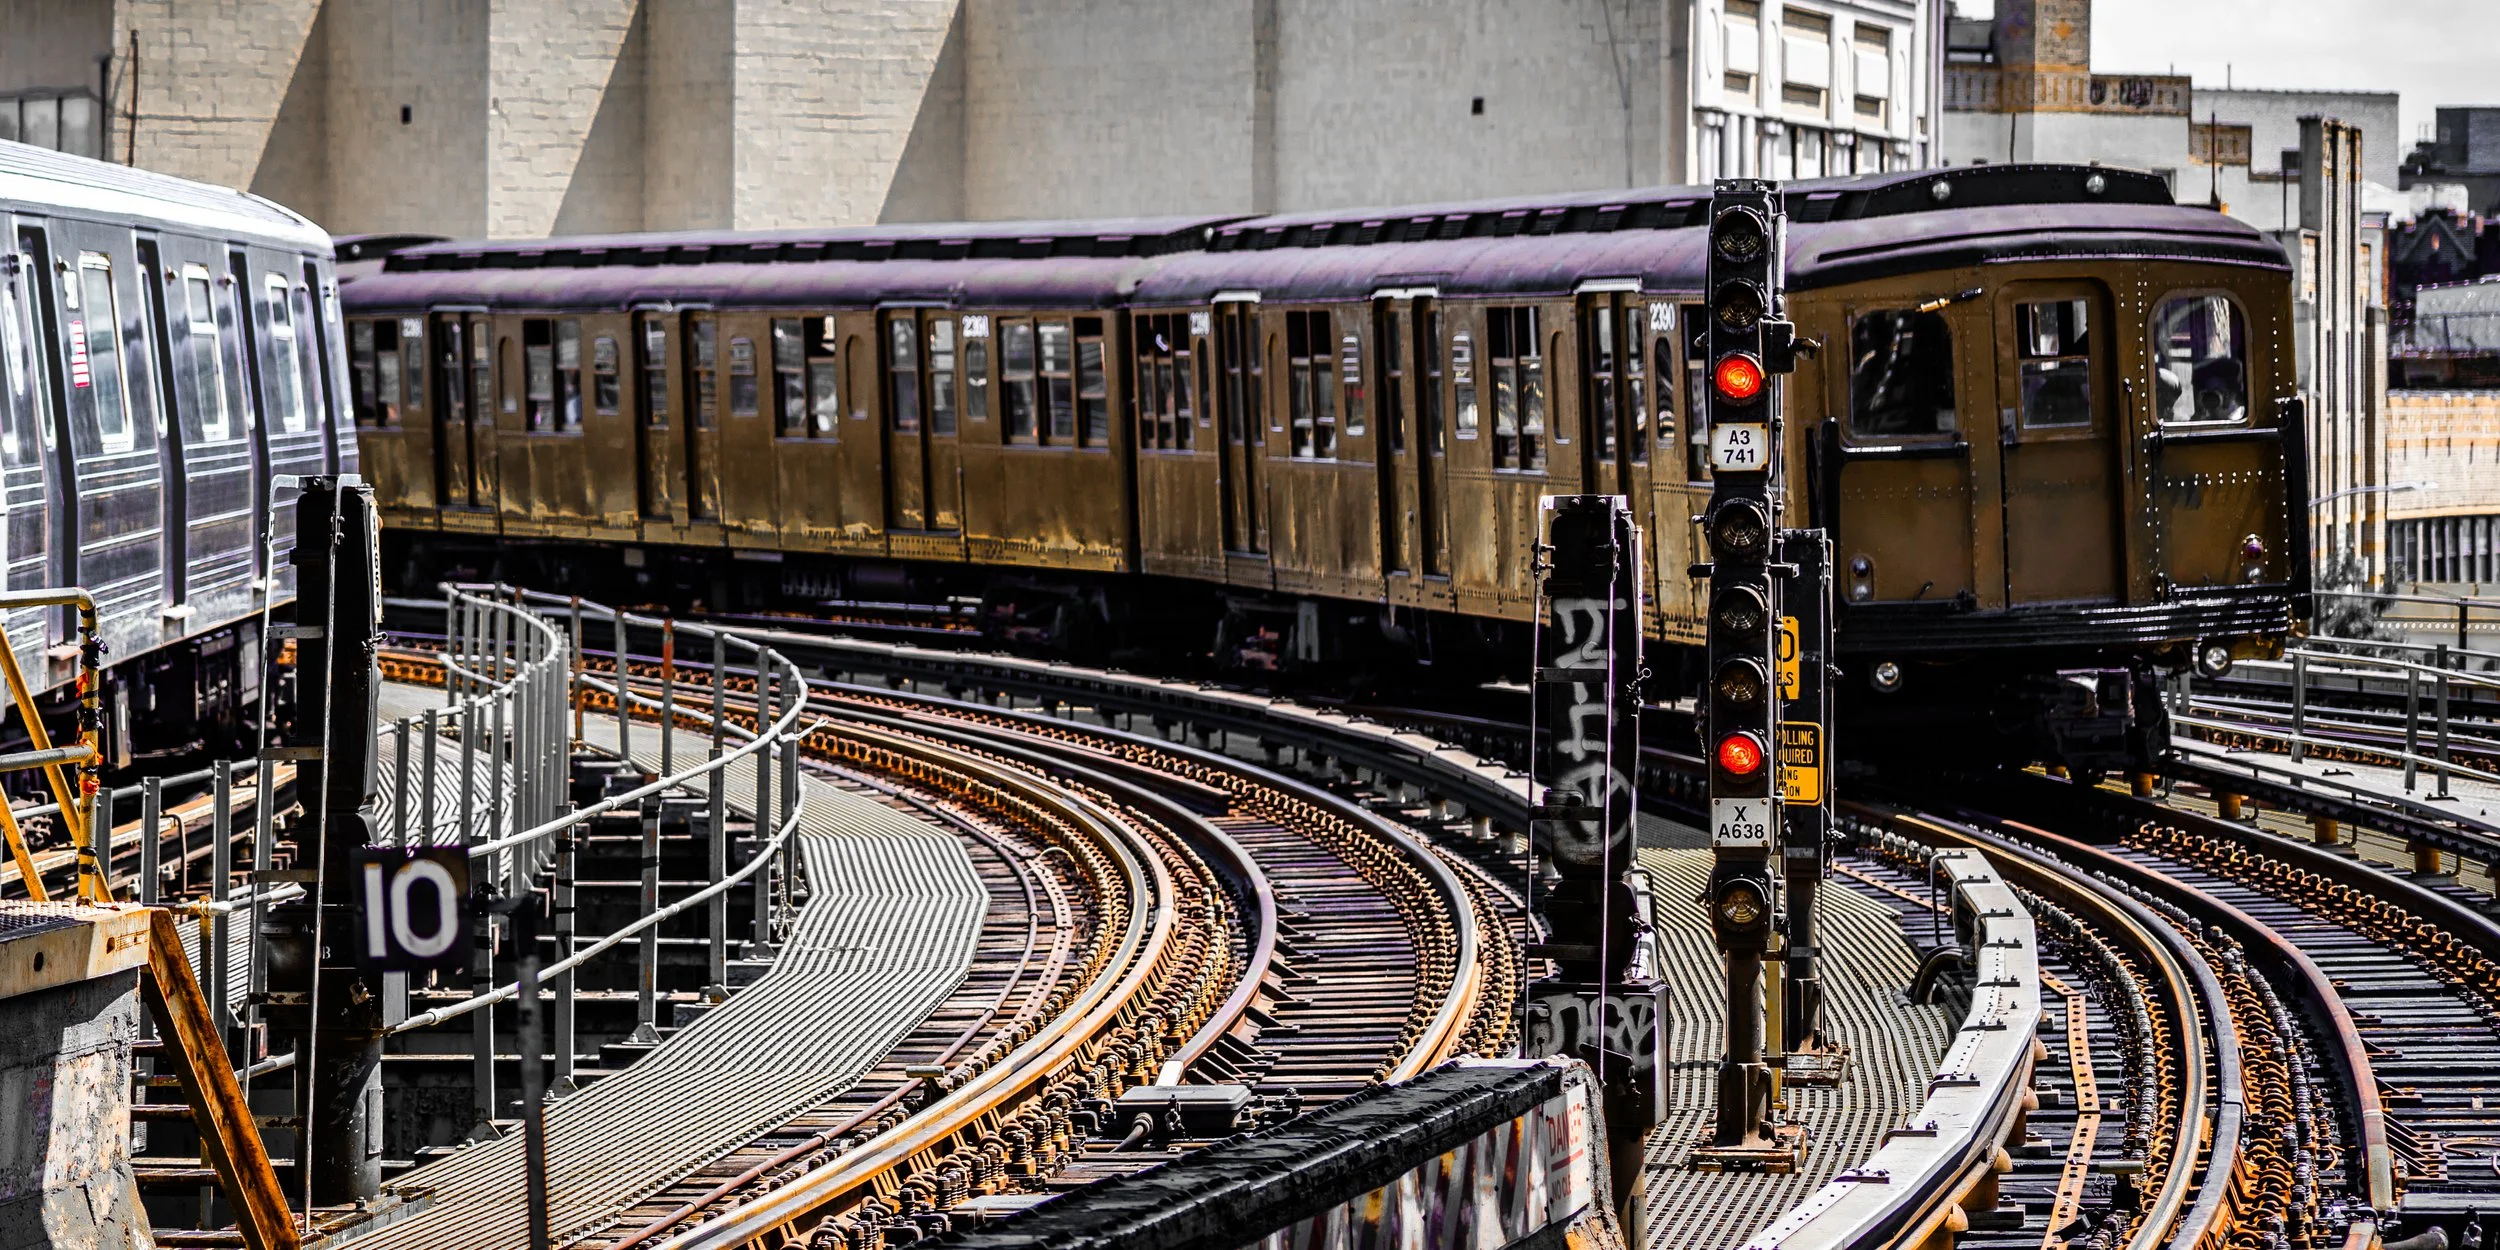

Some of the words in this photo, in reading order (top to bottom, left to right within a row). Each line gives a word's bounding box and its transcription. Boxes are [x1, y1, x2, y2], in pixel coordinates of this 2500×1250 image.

[1650, 302, 1676, 331] 2390
[1729, 430, 1751, 445] A3
[1723, 448, 1754, 464] 741
[1734, 806, 1747, 822] X
[1718, 823, 1765, 839] A638
[364, 859, 459, 957] 10
